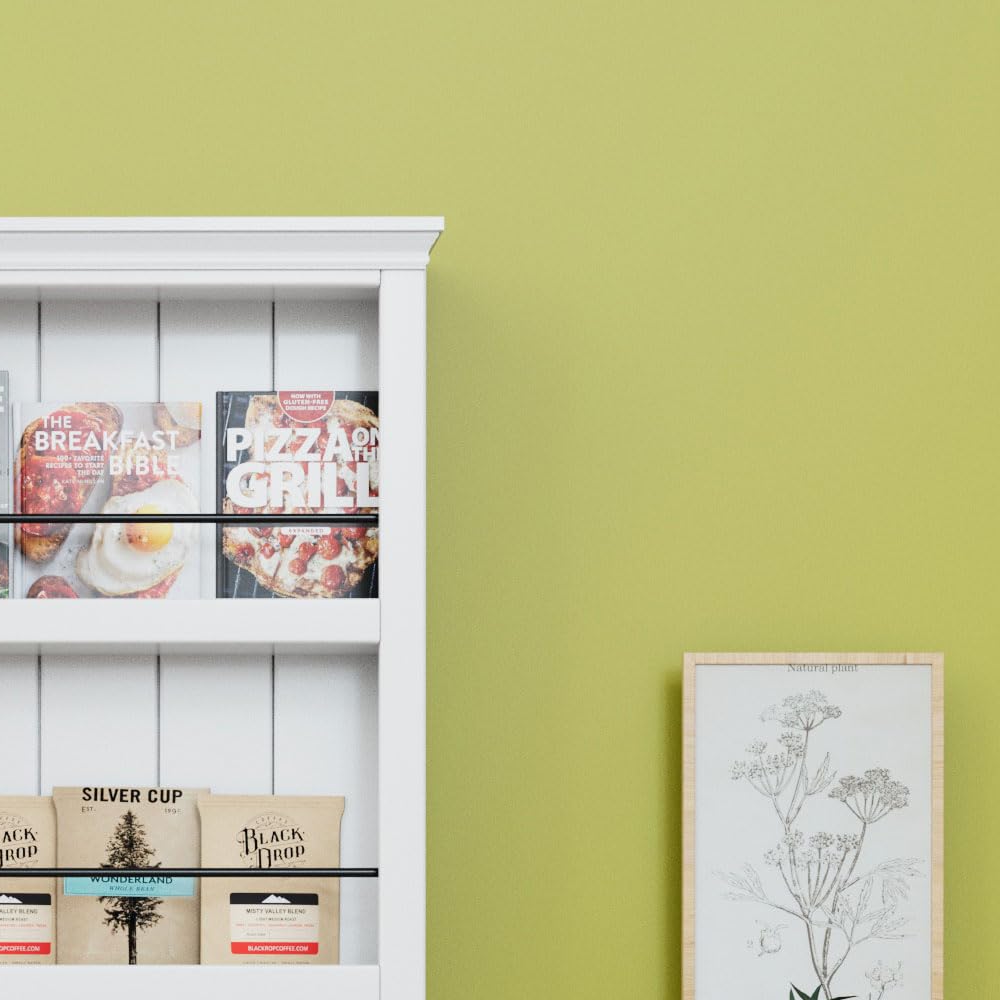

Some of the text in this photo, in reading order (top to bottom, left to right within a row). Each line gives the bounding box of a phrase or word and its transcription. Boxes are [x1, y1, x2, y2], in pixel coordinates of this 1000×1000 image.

[40, 416, 72, 429] THE
[34, 430, 180, 452] BREAKFAST
[226, 427, 354, 462] PIZZA
[109, 455, 180, 476] BIBLE
[226, 462, 379, 508] GRILL
[787, 664, 859, 674] Natural plant
[82, 787, 183, 804] SILVER CUP
[236, 828, 304, 855] BLACK
[258, 845, 305, 868] DROP
[90, 876, 172, 884] WONDERLAND
